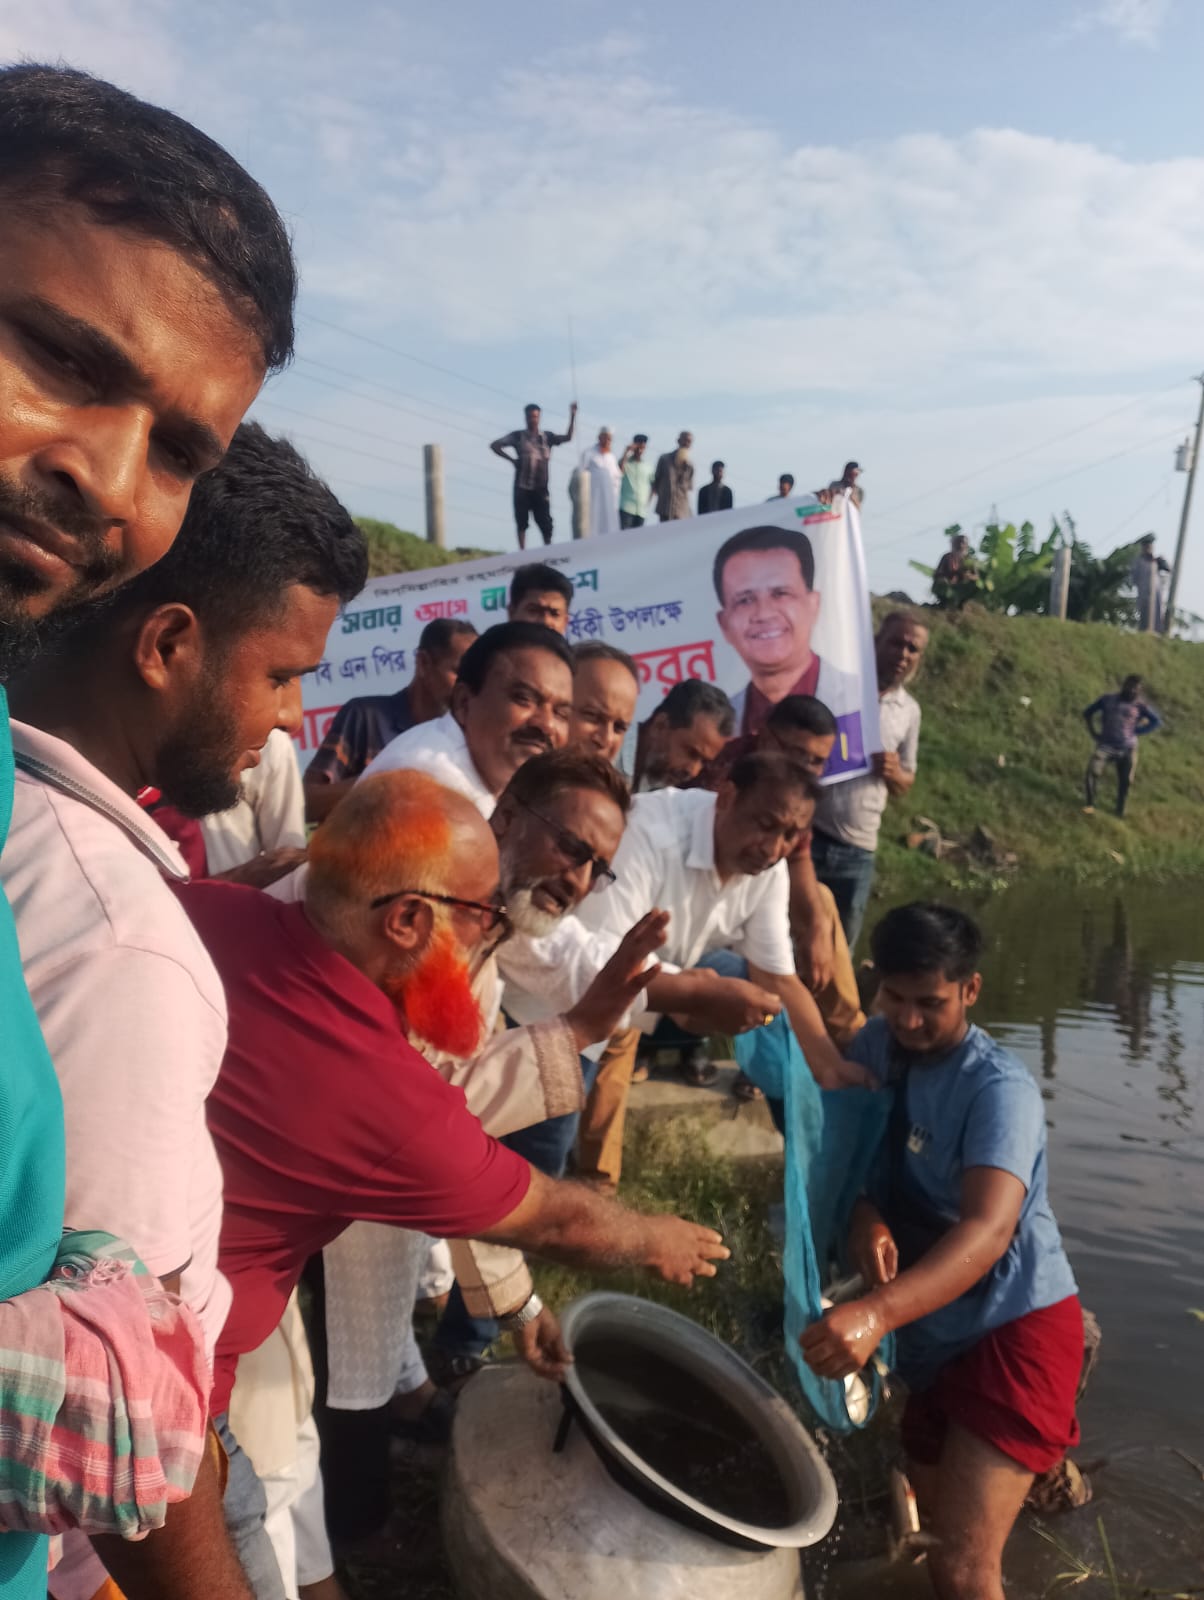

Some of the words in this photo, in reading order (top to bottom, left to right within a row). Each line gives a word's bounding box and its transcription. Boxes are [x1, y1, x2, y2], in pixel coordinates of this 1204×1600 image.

[339, 656, 367, 679] এন
[371, 645, 406, 677] পির
[608, 600, 683, 633] উপলক্ষে
[341, 604, 402, 634] সবার
[414, 598, 468, 622] আগে
